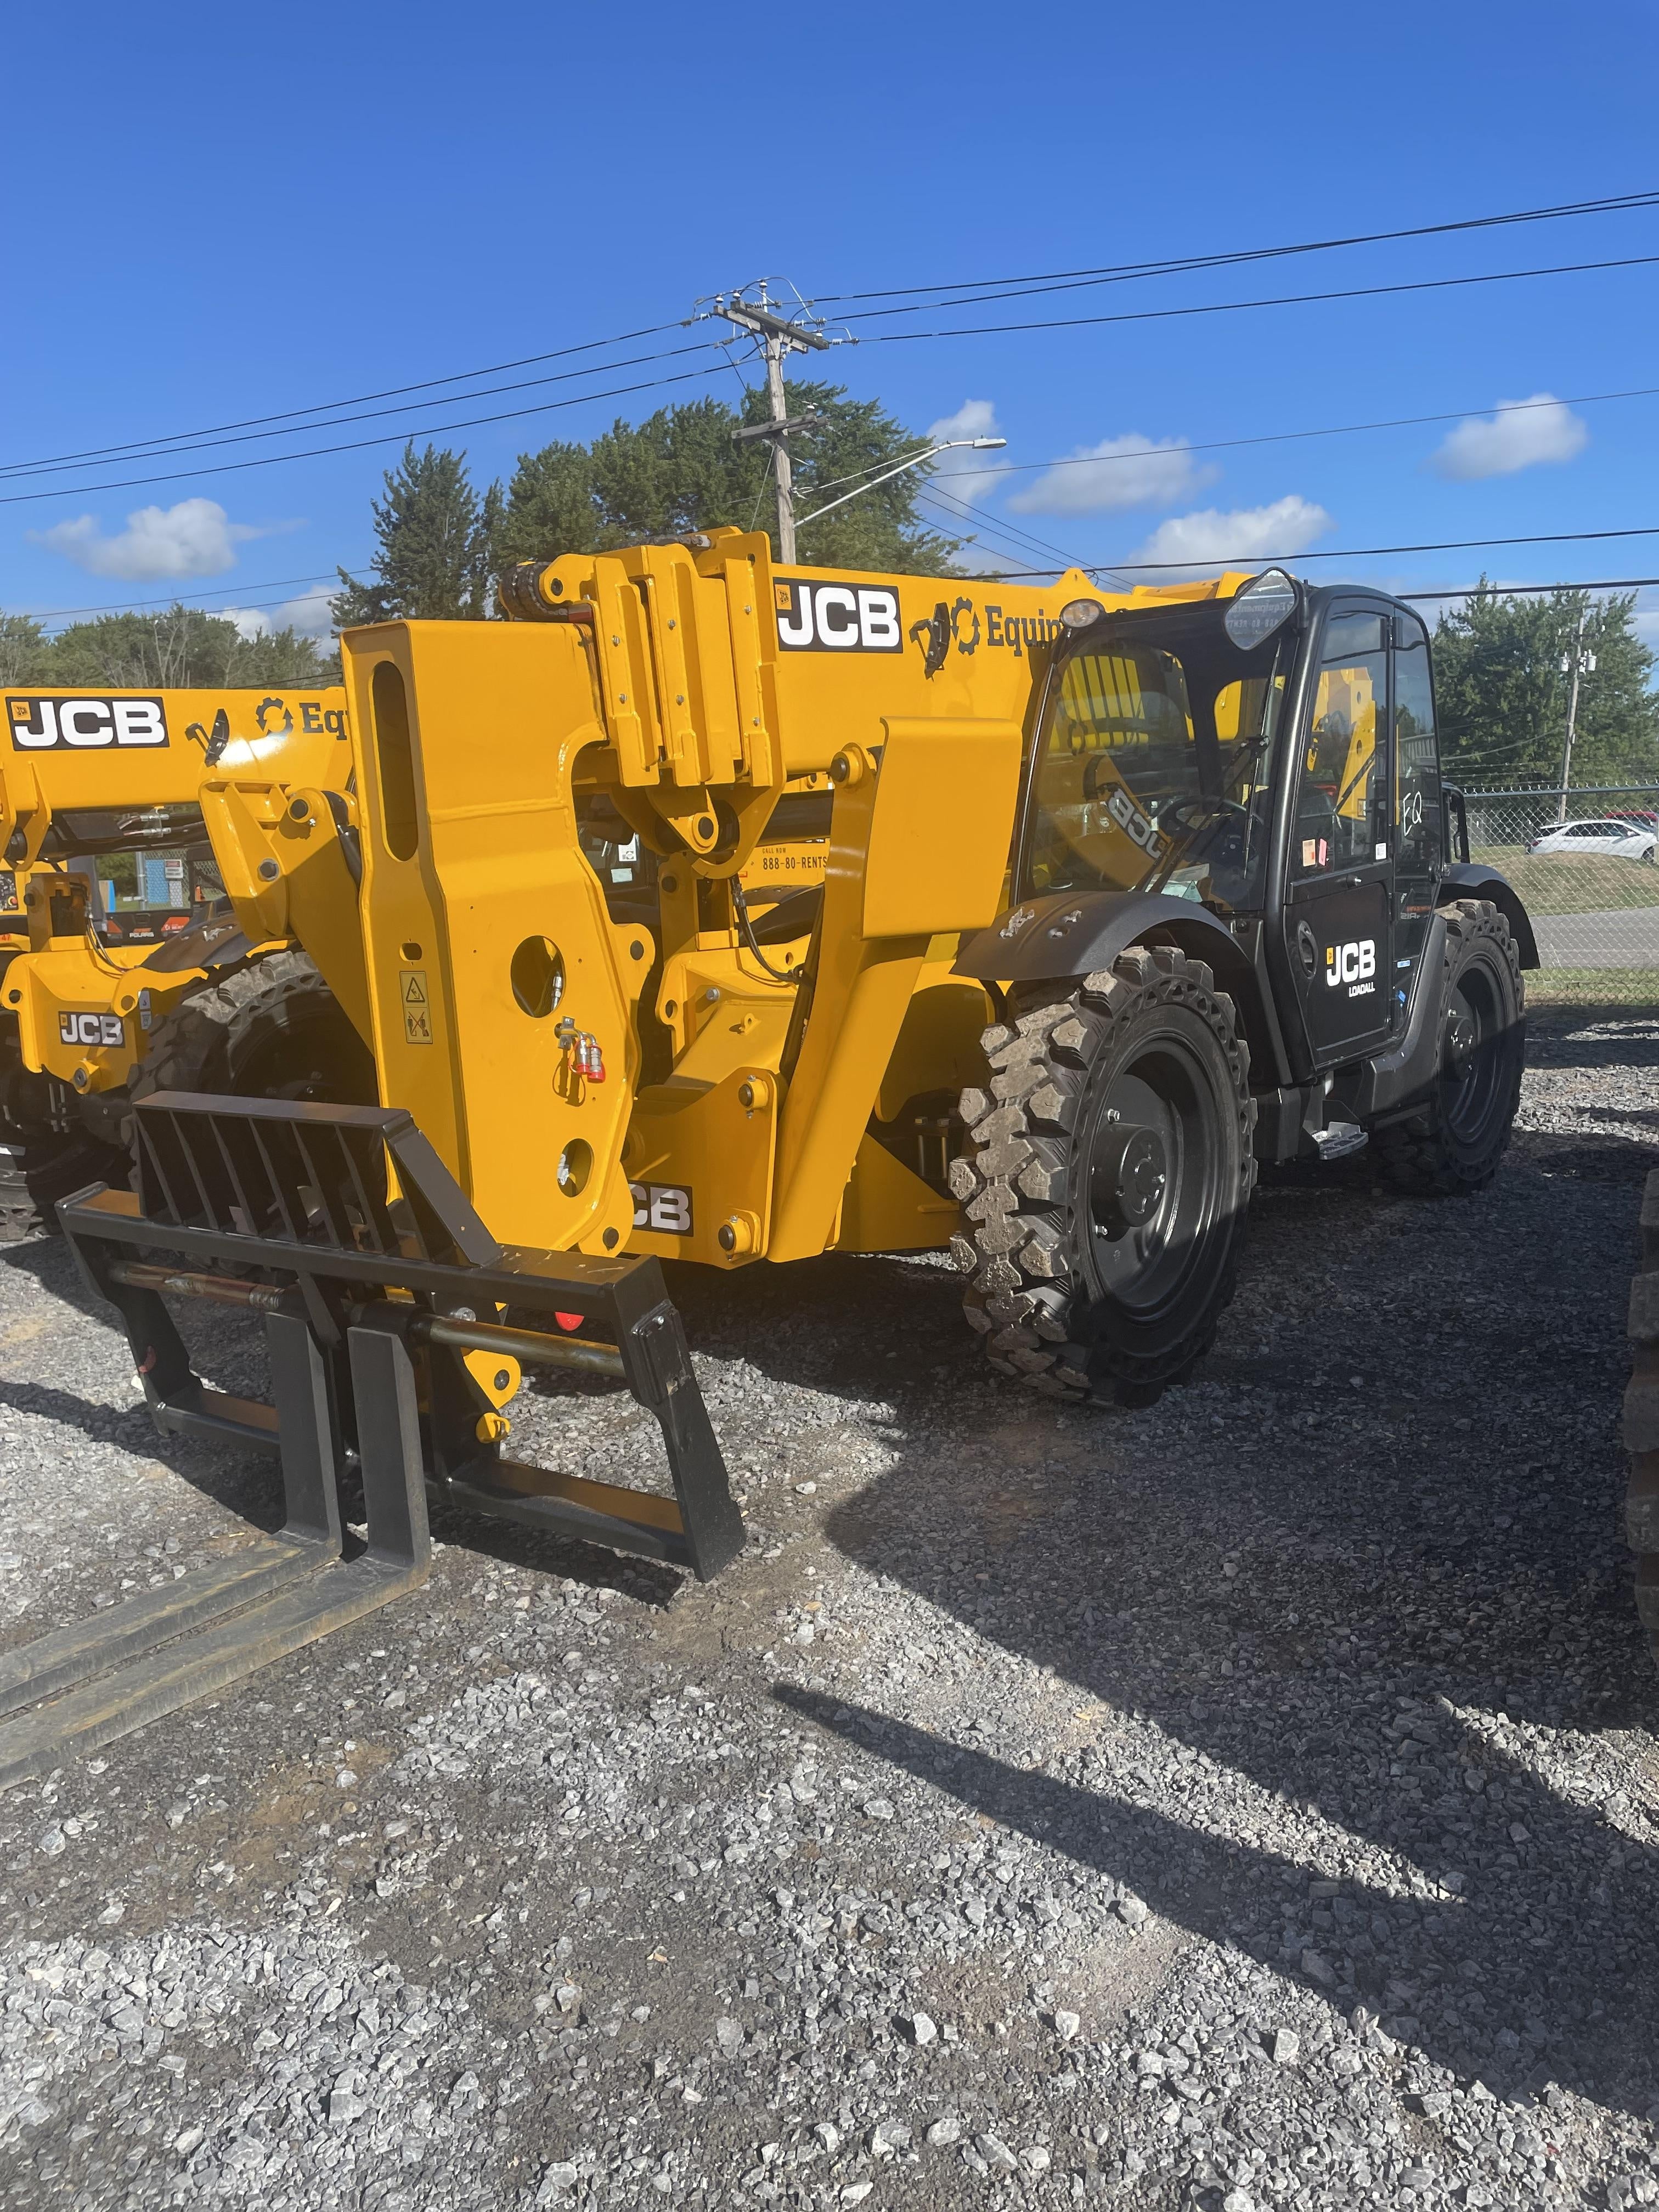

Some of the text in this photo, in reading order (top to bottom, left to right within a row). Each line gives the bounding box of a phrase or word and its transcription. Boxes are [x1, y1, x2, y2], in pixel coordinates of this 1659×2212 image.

[778, 585, 900, 647] JCB
[984, 605, 1061, 657] Equip
[14, 701, 165, 747] JCB
[298, 702, 348, 741] Eq
[1403, 791, 1422, 836] EQ
[763, 856, 828, 870] 888-80-RENTS
[1327, 939, 1376, 986] JCB
[1348, 981, 1375, 997] LOADALL
[61, 1014, 123, 1045] JCB
[628, 1183, 691, 1231] CB
